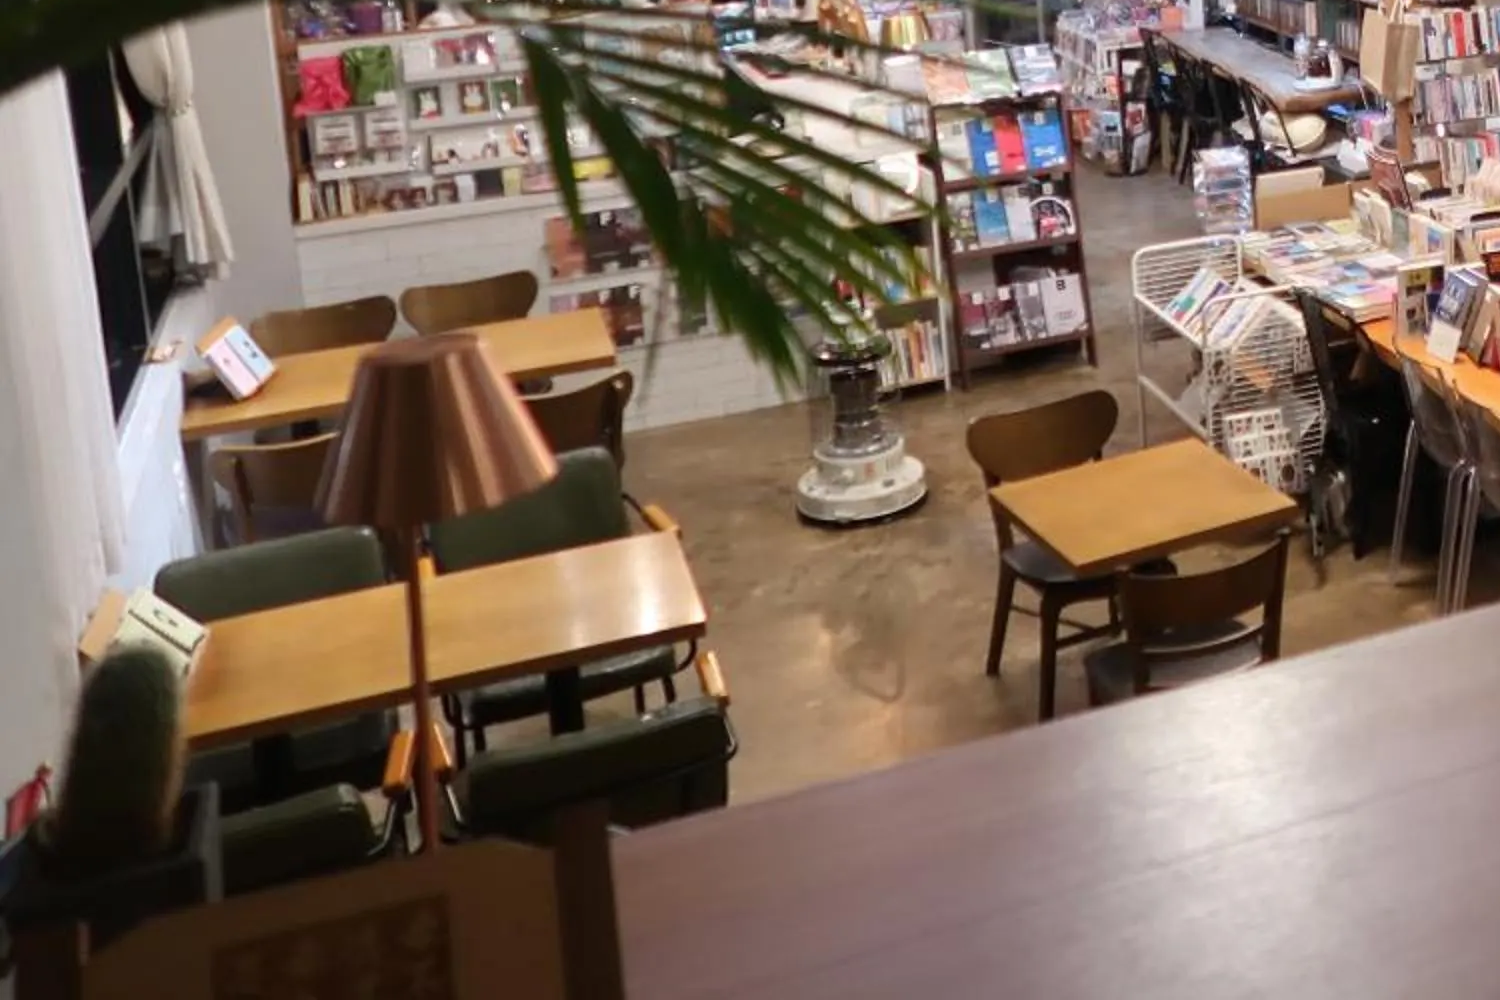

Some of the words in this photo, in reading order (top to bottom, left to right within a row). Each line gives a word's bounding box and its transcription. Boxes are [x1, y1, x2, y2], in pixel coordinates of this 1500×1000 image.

[600, 211, 611, 226] F
[629, 285, 640, 299] F
[1056, 279, 1066, 291] B
